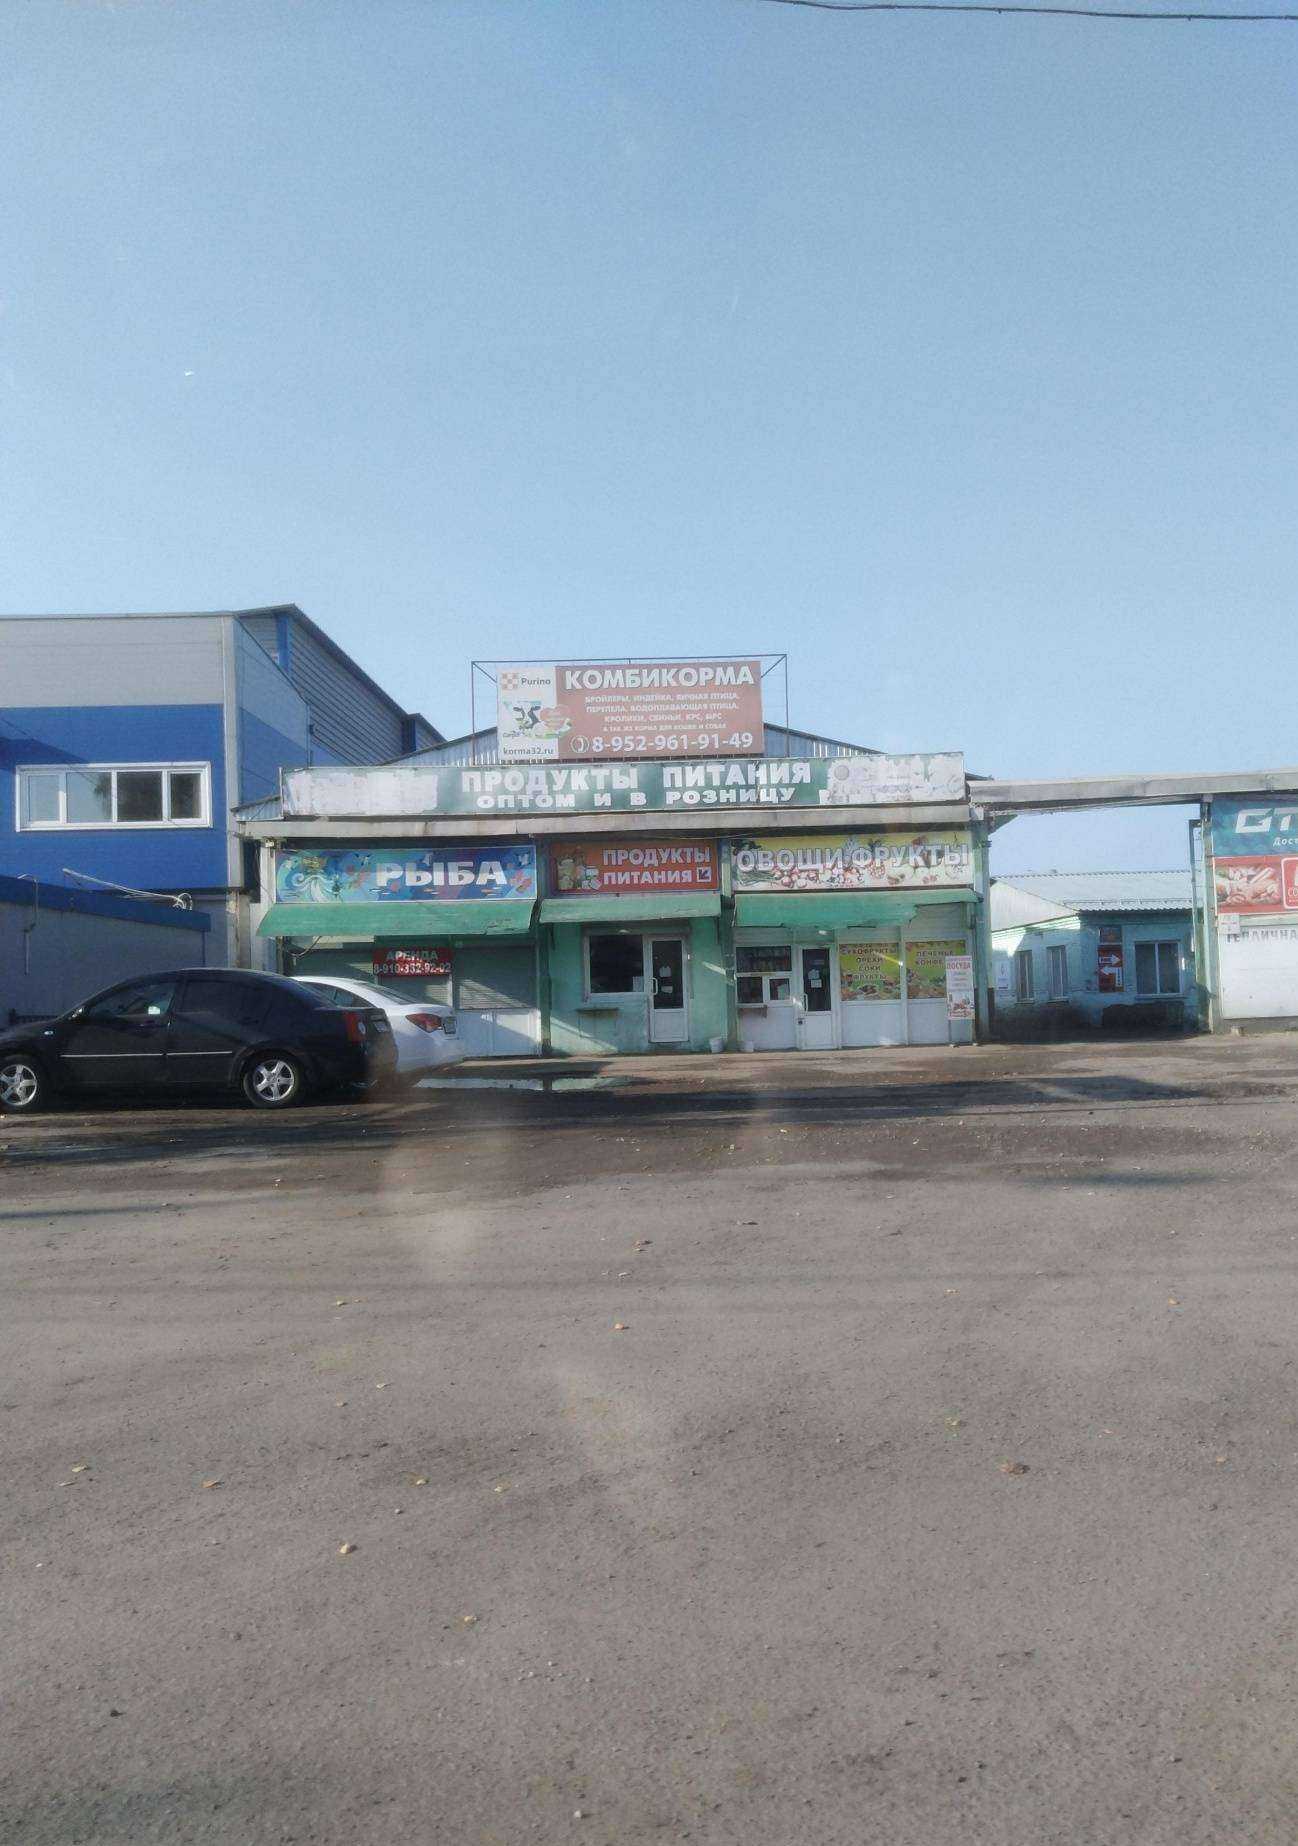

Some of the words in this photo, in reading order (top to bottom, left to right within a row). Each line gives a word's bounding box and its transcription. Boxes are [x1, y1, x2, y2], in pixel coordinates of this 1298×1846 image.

[565, 665, 755, 690] КОМБИКОРМА
[502, 747, 554, 756] korma32.ru
[591, 732, 754, 752] 8-952-961-91-49
[460, 768, 638, 796] ПРОДУКТЫ
[662, 762, 812, 787] ПИТАНИЯ
[476, 793, 575, 809] ОПТОМ
[594, 792, 612, 807] И
[631, 791, 648, 806] В
[666, 787, 796, 805] РОЗНИЦУ
[602, 847, 711, 867] ПРОДУКТЫ
[736, 848, 844, 873] ОВОЩИ
[850, 843, 969, 868] ФРУКТЫ
[375, 861, 509, 887] РЫБА
[602, 870, 693, 886] ПИТАНИЯ
[386, 950, 439, 961] АРЕНДА
